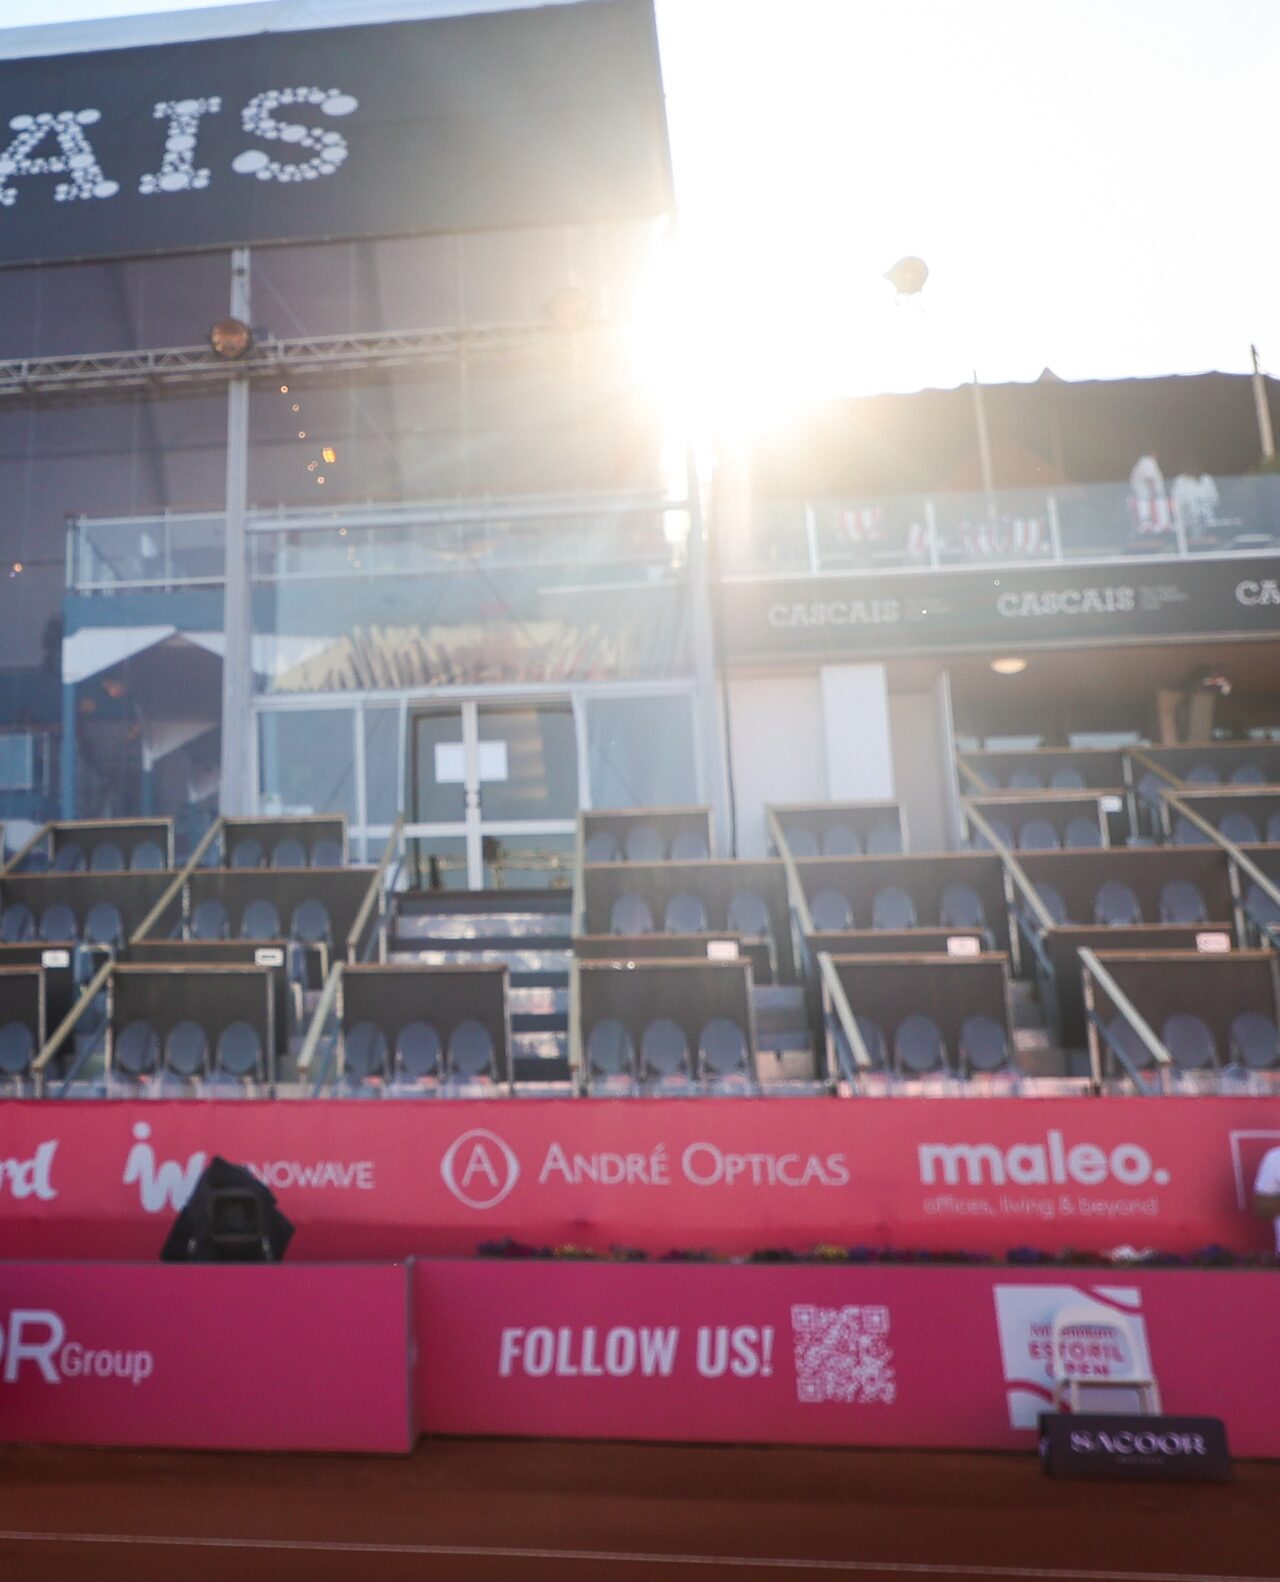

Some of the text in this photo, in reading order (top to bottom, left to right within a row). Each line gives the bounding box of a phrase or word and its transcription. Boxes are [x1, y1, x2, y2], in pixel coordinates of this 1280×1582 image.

[768, 598, 901, 627] CASCAIS
[996, 586, 1136, 617] CASCAIS
[538, 1141, 850, 1185] ANDRÉ OPTICAS
[60, 1343, 153, 1385] Group
[499, 1326, 774, 1377] FOLLOW US!
[1070, 1431, 1206, 1456] SACOOR
